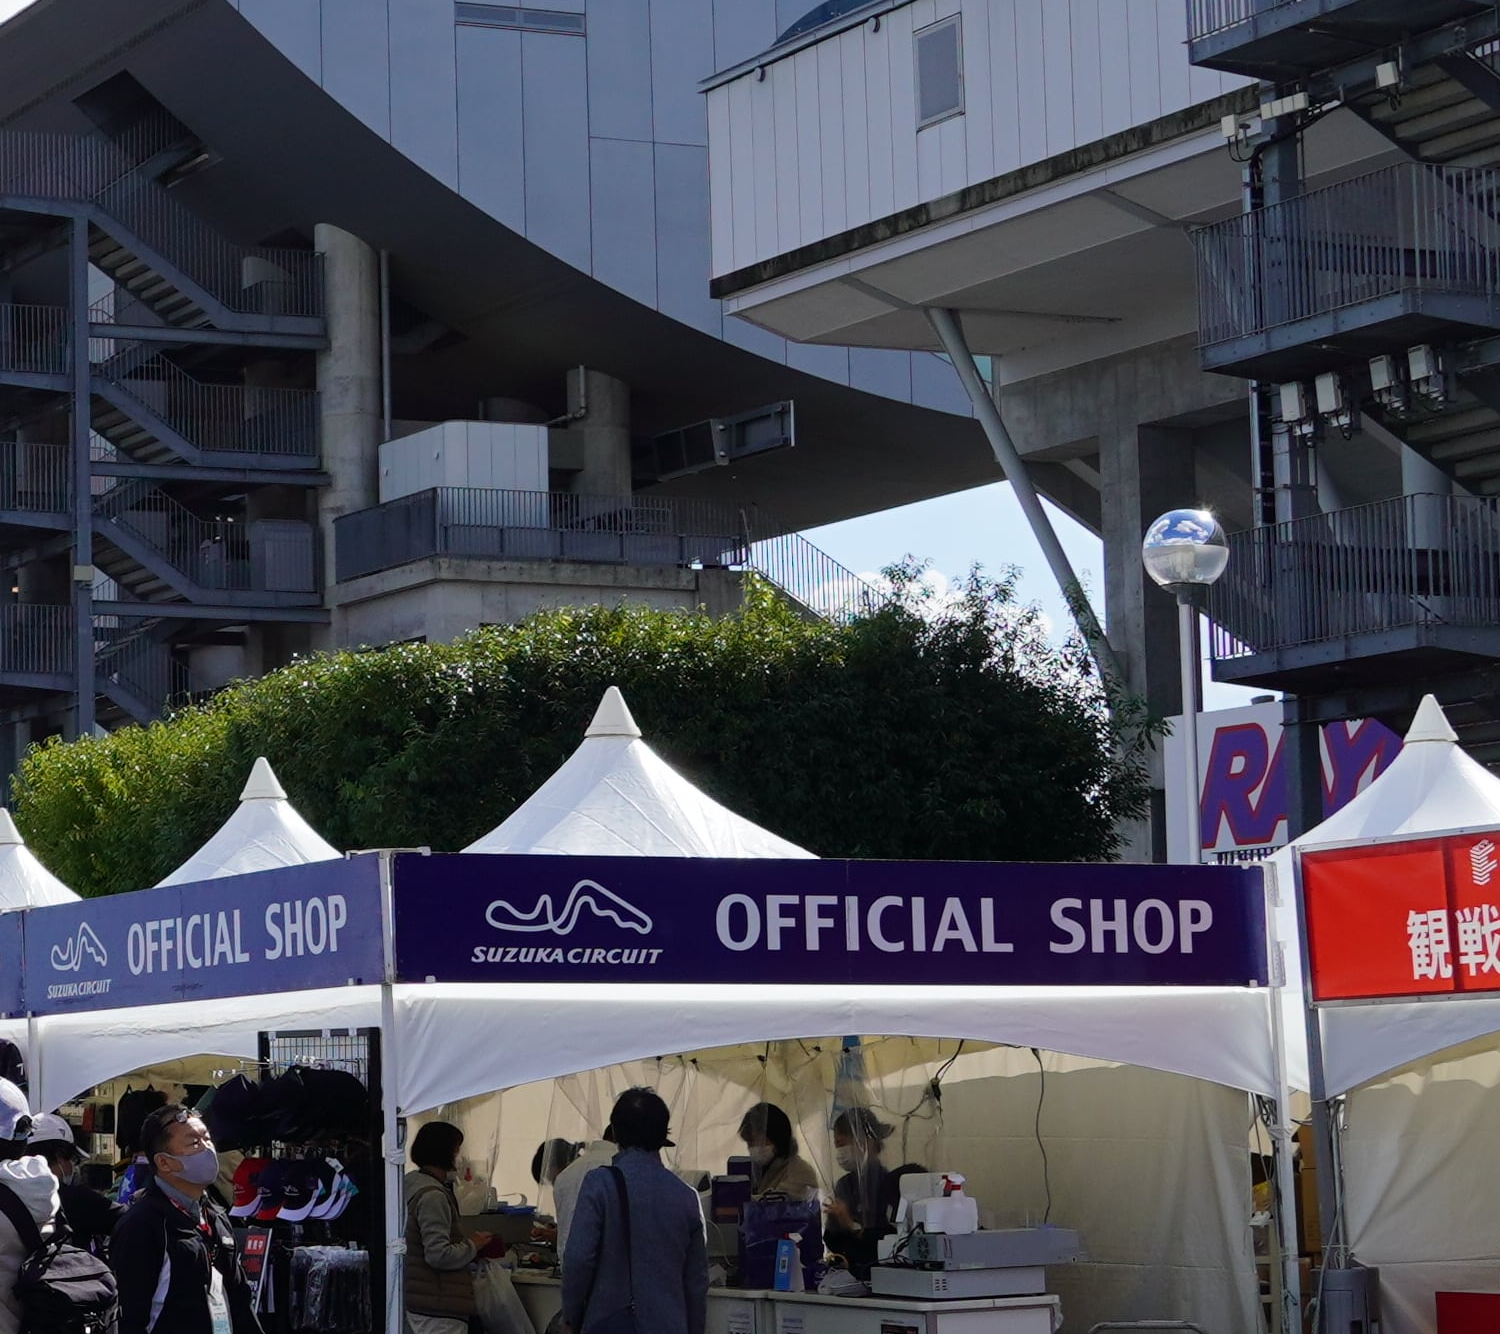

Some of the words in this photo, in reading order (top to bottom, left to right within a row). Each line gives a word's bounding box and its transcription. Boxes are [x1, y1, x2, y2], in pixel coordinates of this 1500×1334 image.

[127, 909, 250, 976] OFFICIAL
[264, 894, 347, 960] SHOP
[715, 894, 1014, 953] OFFICIAL
[1049, 897, 1214, 955] SHOP
